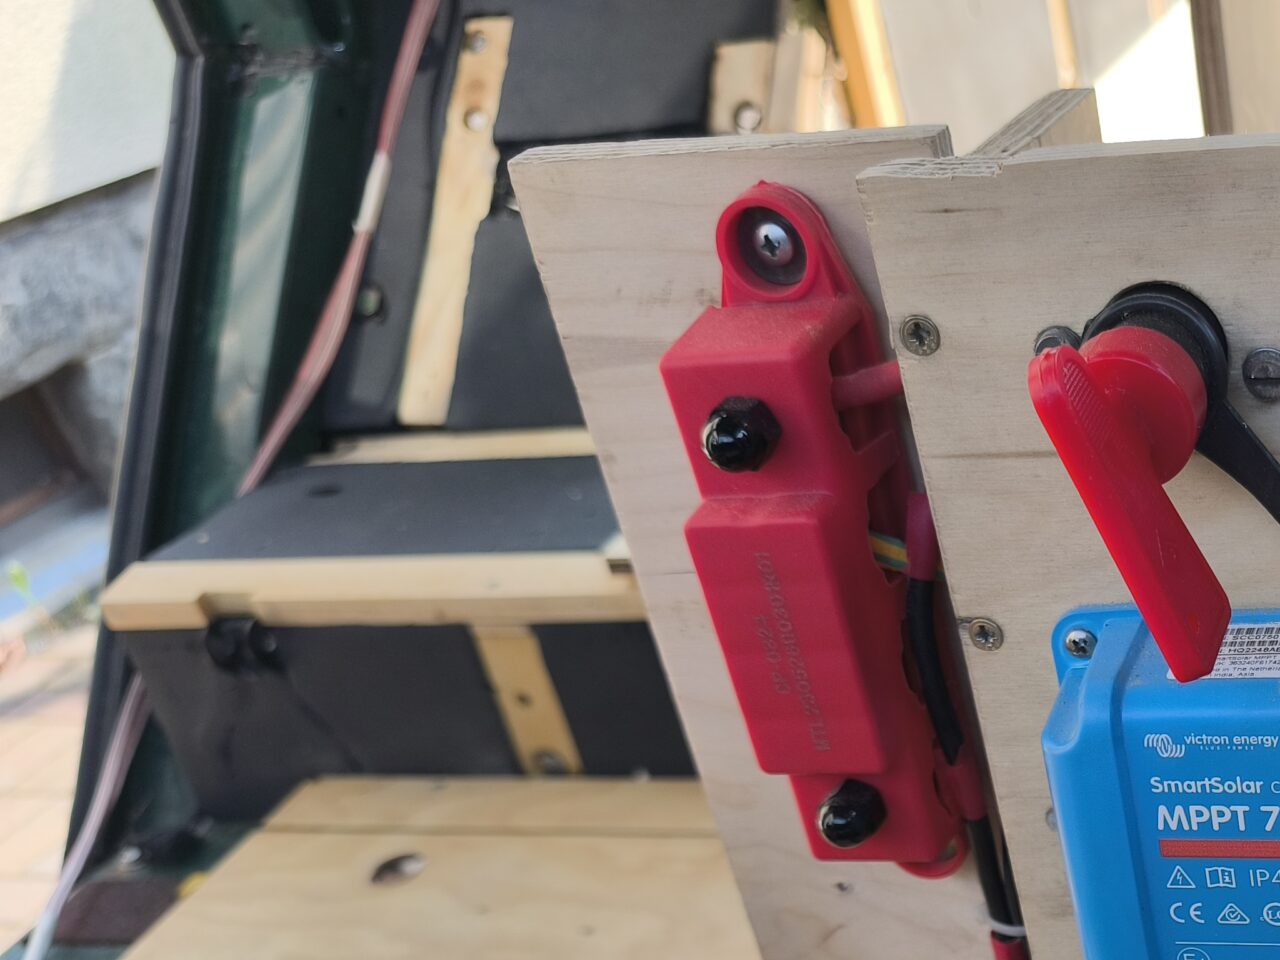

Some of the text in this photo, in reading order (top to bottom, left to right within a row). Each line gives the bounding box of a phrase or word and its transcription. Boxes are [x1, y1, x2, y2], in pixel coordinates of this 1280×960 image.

[1183, 732, 1279, 748] victron energy
[1150, 776, 1264, 794] SmartSolar
[1157, 805, 1250, 832] MPPT
